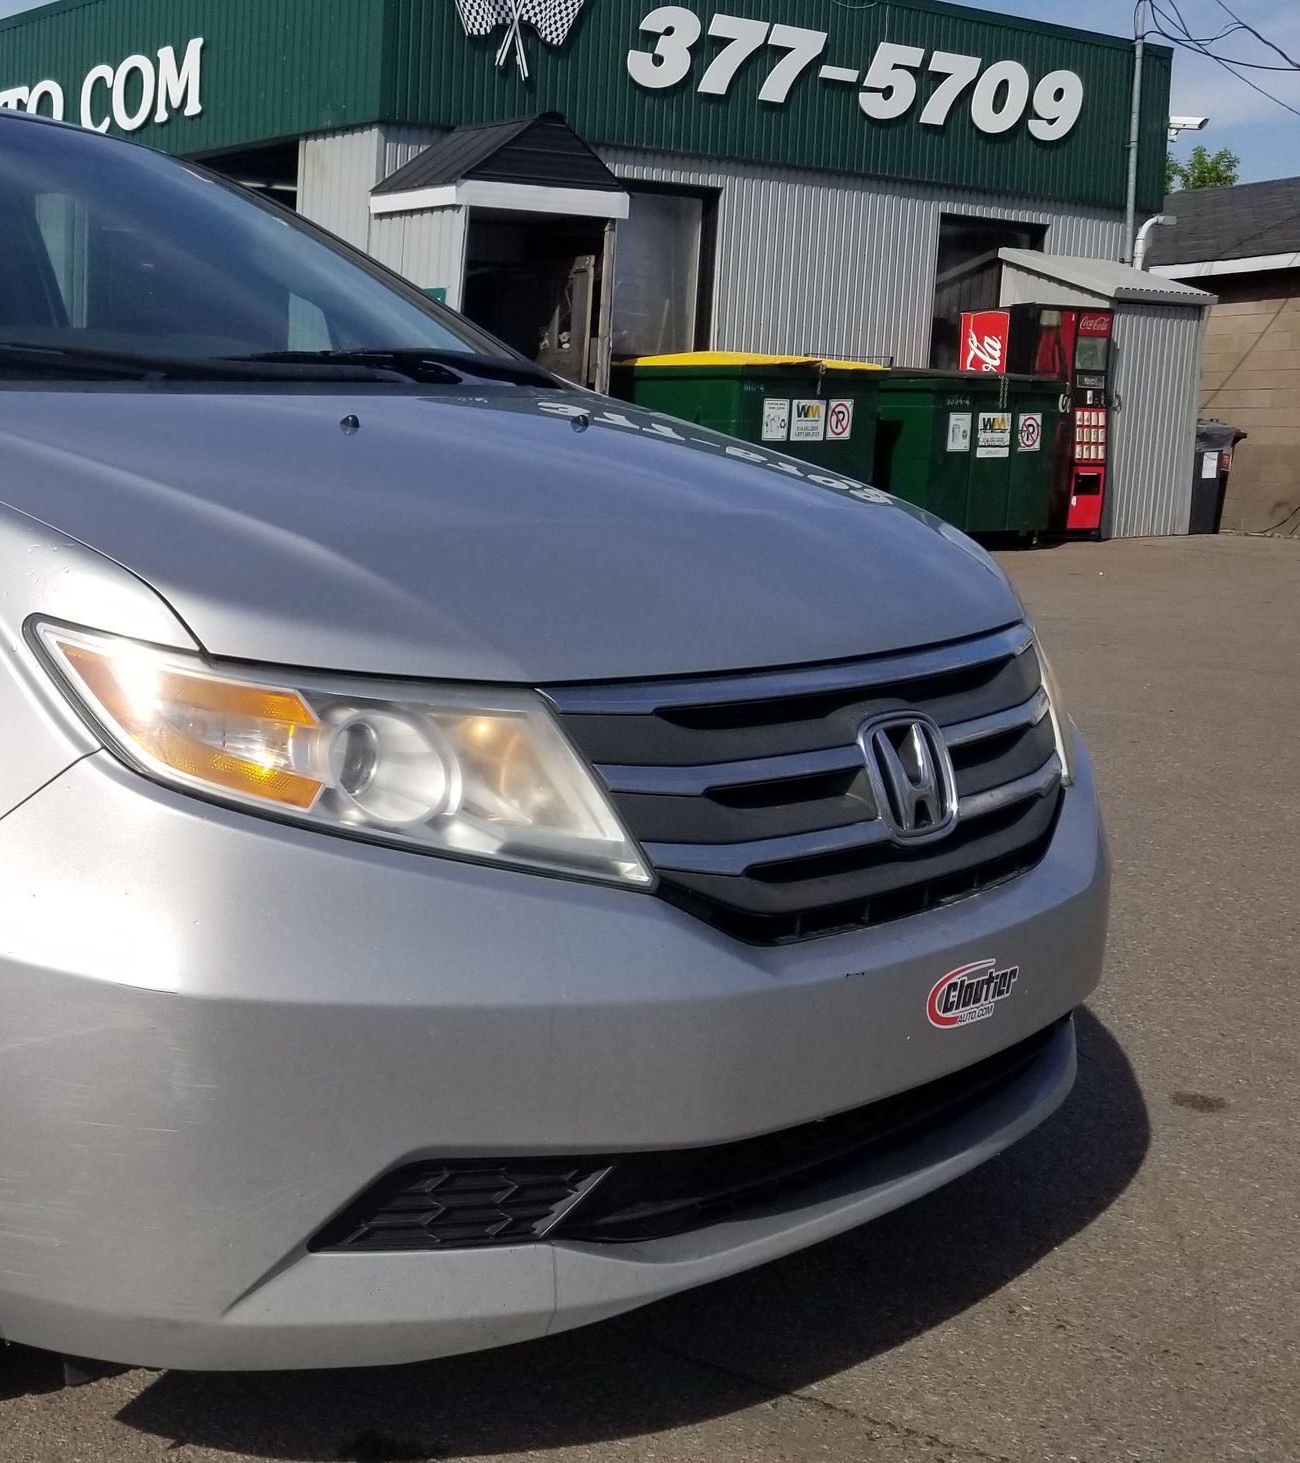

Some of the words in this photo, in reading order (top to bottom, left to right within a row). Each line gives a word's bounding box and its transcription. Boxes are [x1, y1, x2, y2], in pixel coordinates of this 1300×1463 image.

[627, 6, 1083, 141] 377-5709
[796, 404, 821, 419] WM
[982, 417, 1006, 430] WM
[942, 968, 1019, 1014] Cloutier
